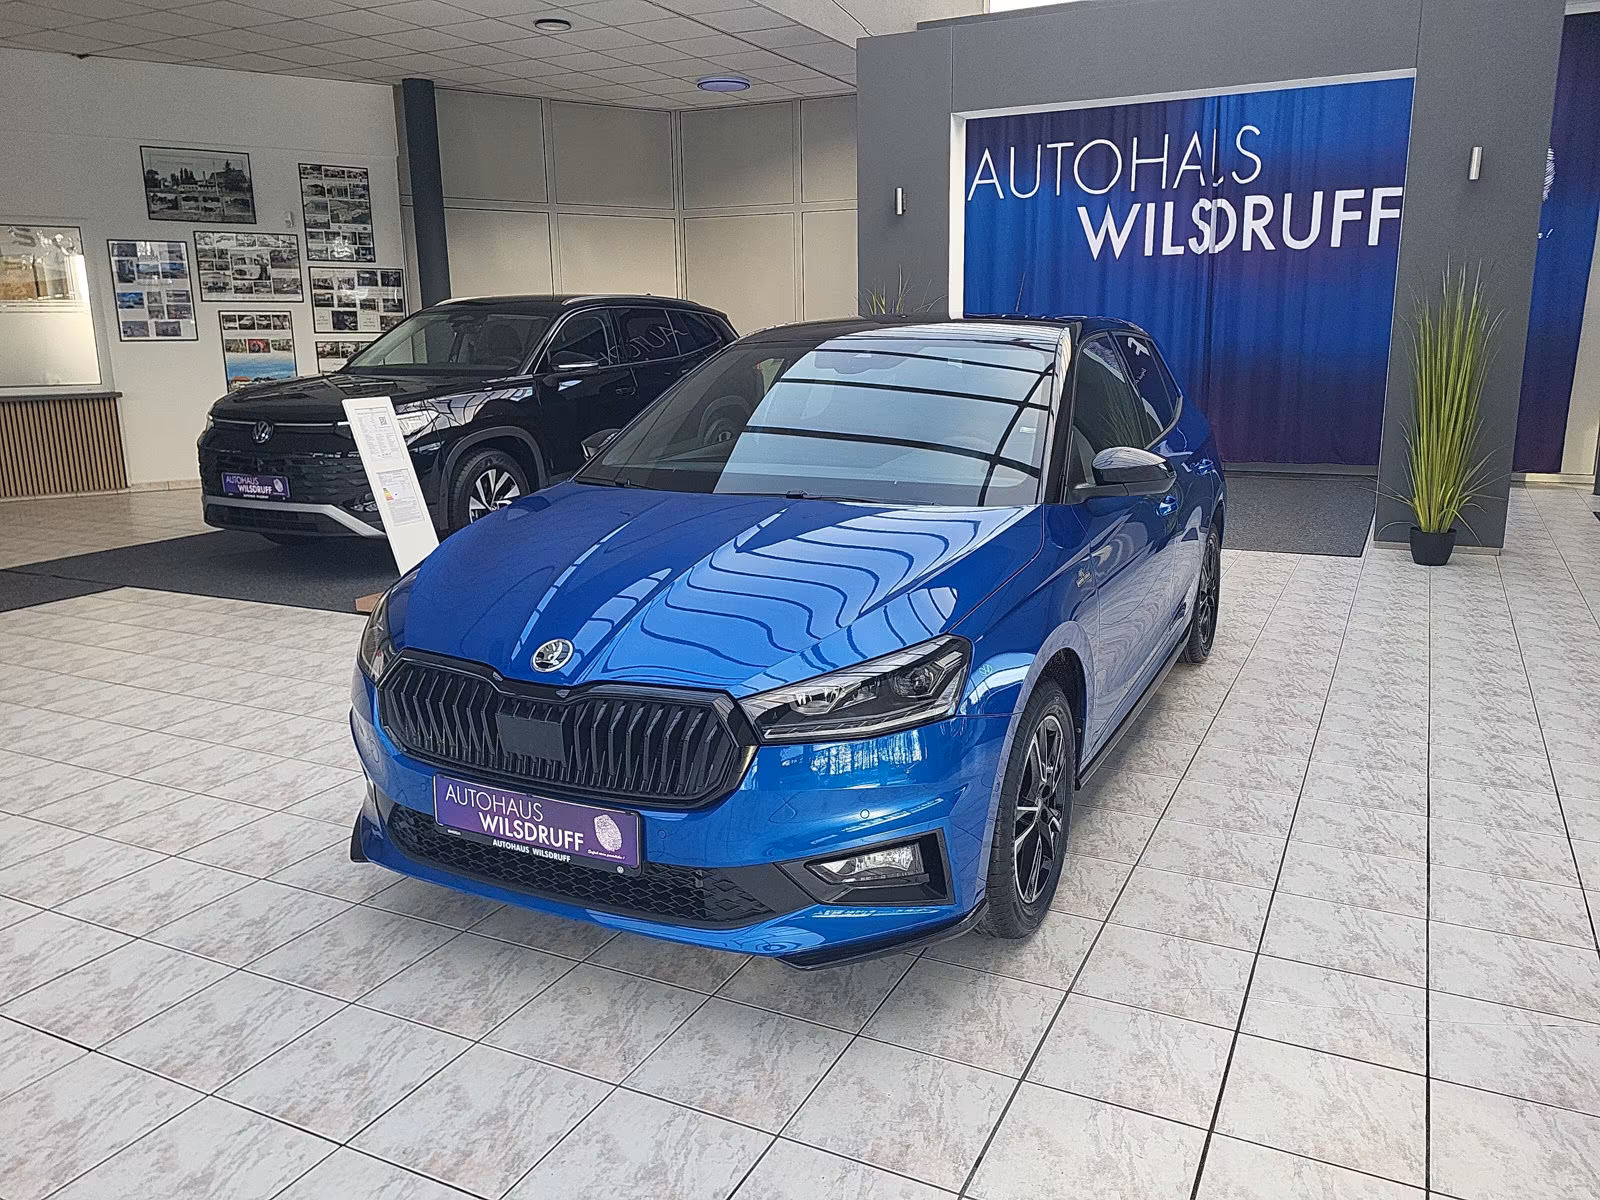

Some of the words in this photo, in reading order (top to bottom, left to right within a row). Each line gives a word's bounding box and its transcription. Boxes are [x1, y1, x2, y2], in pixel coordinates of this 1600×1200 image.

[1076, 186, 1404, 261] WILSDRUFF
[225, 476, 259, 485] AUTOHAUS
[238, 484, 272, 494] WILSDRUFF
[445, 783, 544, 822] AUTOHAUS
[478, 811, 584, 851] WILSDRUFF
[492, 838, 530, 854] AUTOHAUS
[532, 847, 571, 863] WILSDRUFF
